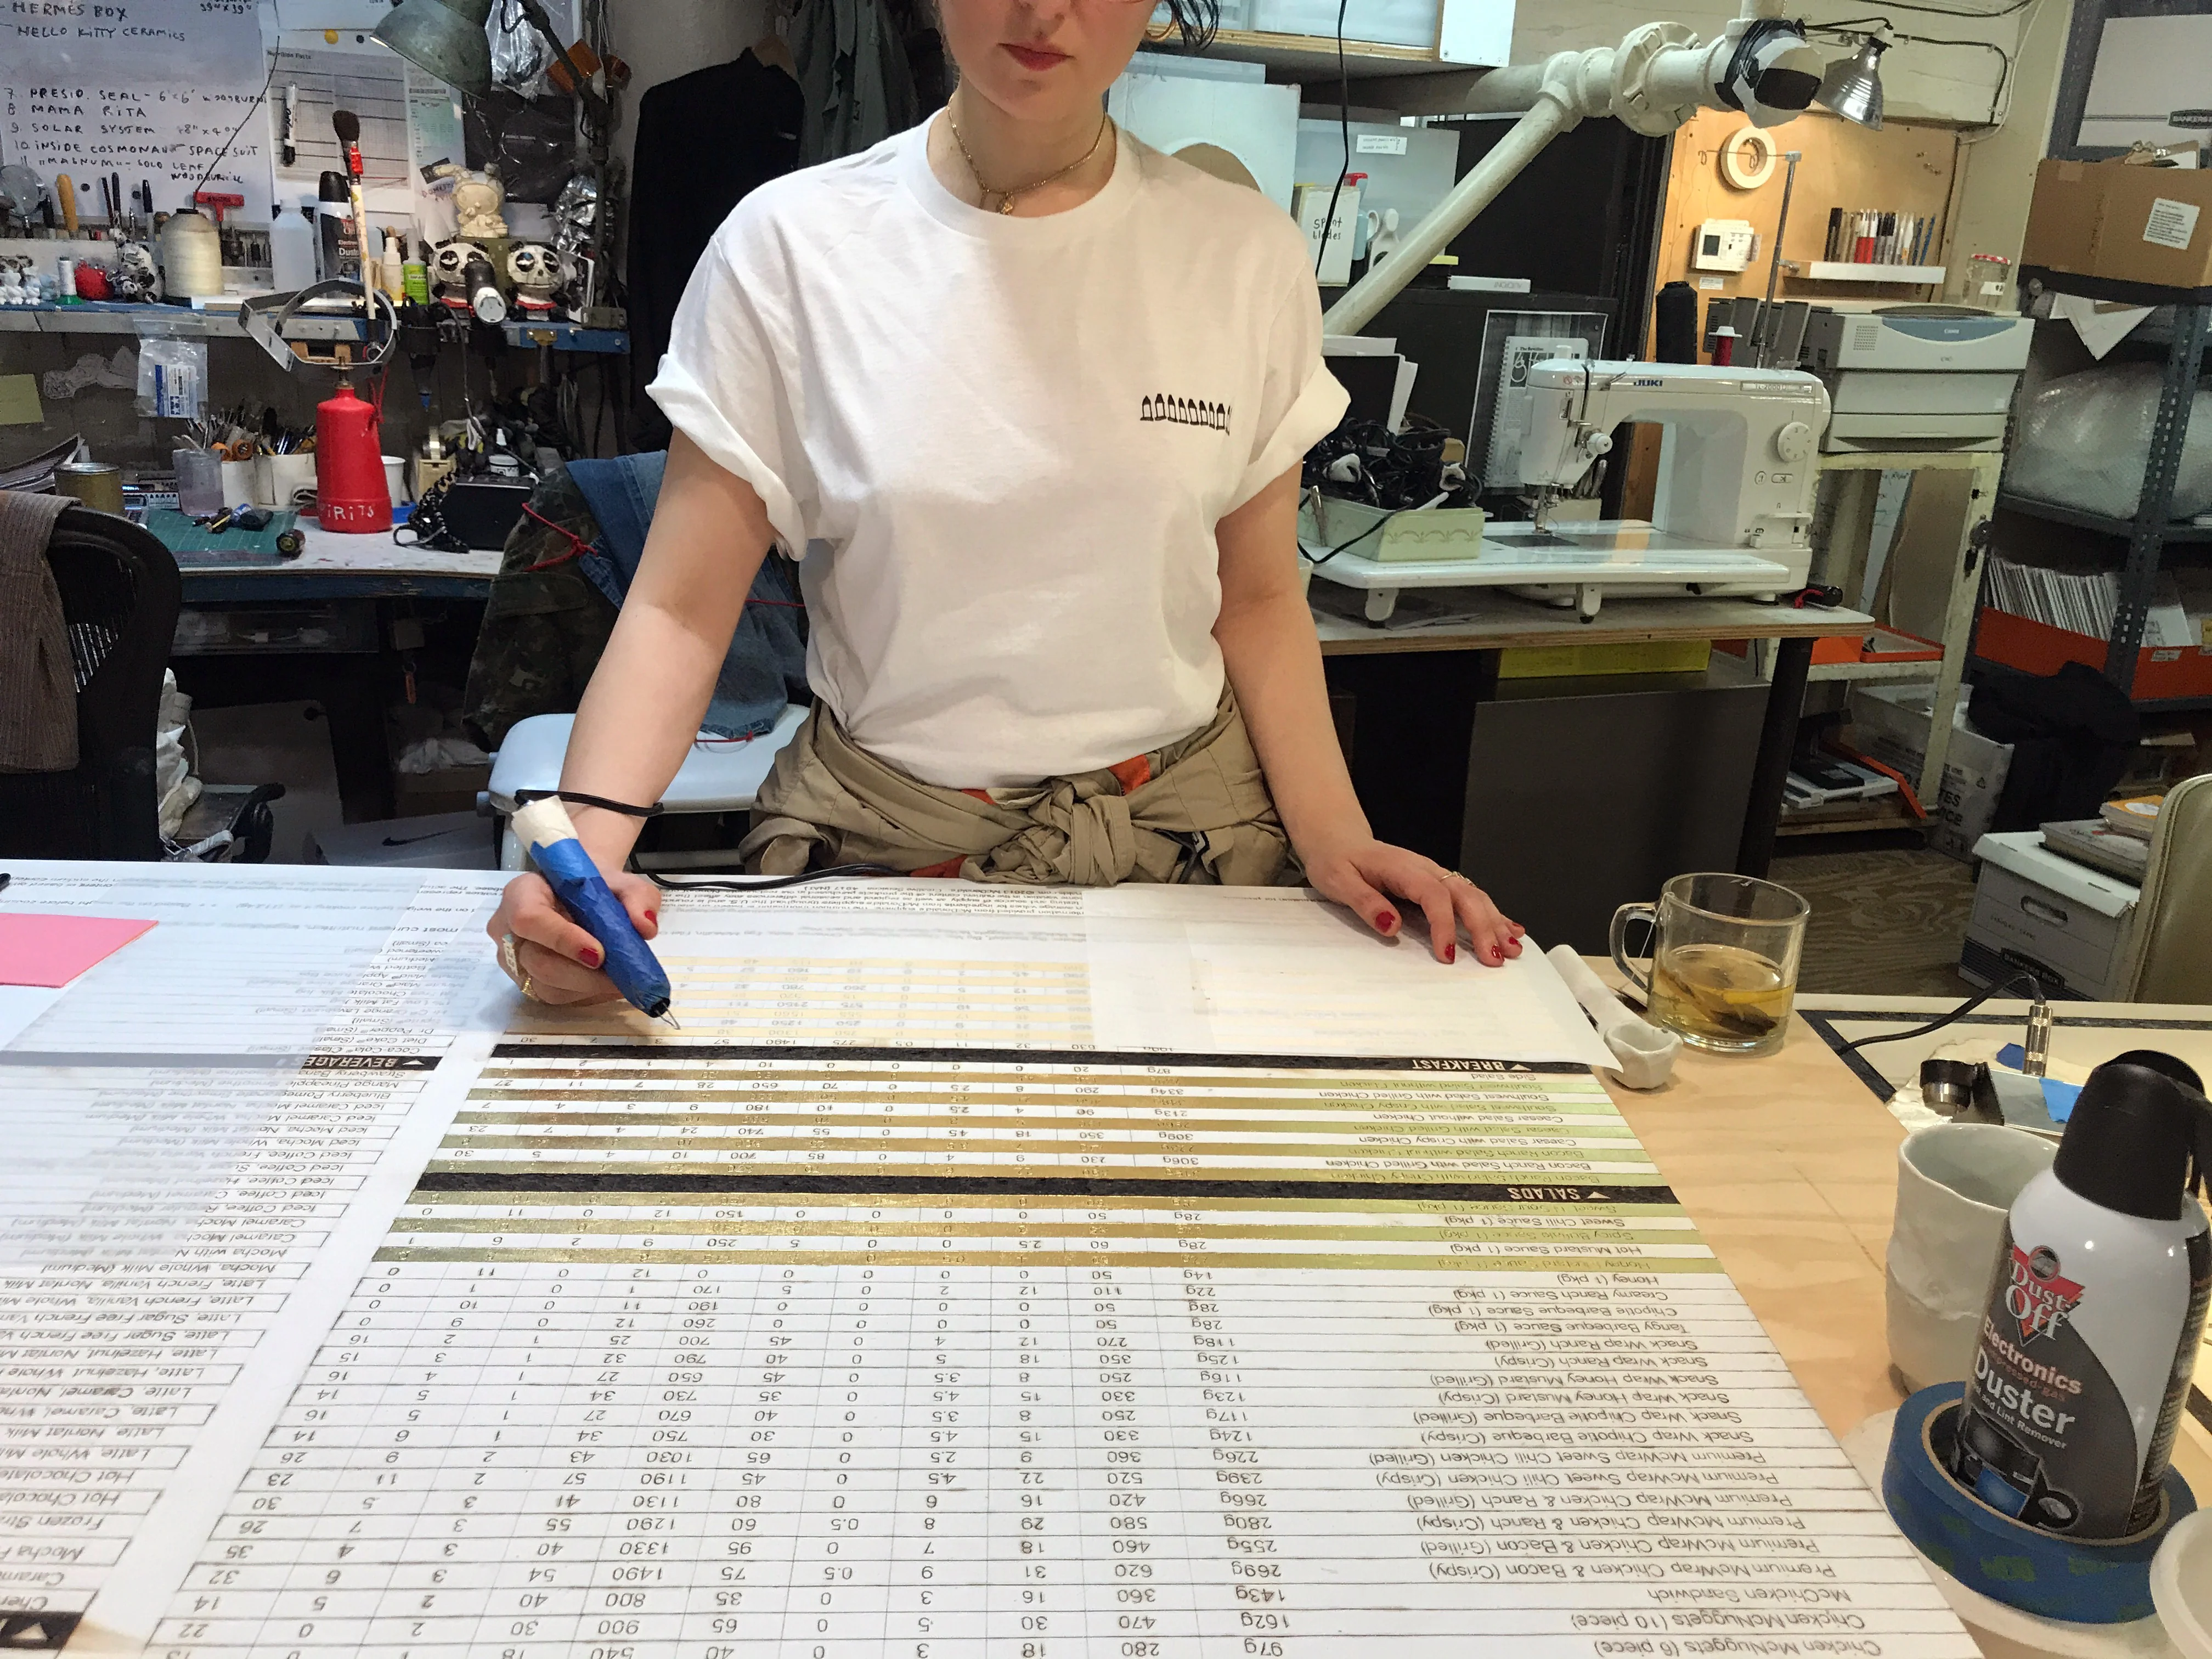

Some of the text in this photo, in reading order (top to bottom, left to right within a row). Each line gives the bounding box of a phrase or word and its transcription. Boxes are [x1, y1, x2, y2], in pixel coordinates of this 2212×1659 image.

[94, 5, 129, 21] BOX
[18, 27, 68, 39] HELLO
[99, 90, 140, 101] SEAL
[31, 105, 84, 115] MAMA
[32, 123, 83, 134] SOLAR
[100, 125, 155, 134] SYSTEM
[1313, 229, 1341, 240] bldes
[1412, 1059, 1505, 1071] BREAKFAST
[335, 1070, 405, 1078] Strawberry
[1373, 1091, 1417, 1099] Grilled
[1482, 1093, 1549, 1101] Southwest
[296, 1102, 349, 1110] Caramel
[1158, 1132, 1455, 1146] Crispy 309g
[1162, 1156, 1199, 1165] 306g
[291, 1191, 326, 1199] Iced
[1507, 1187, 1581, 1199] SALADS
[715, 1209, 1625, 1227] Sweet Chili Sauce 28g 150
[233, 1249, 287, 1257] Mocha
[1554, 1246, 1611, 1254] Mustard
[159, 1263, 210, 1273] Whole
[39, 1279, 93, 1290] Nonfat
[157, 1279, 212, 1289] French
[1557, 1274, 1589, 1285] pkg)
[1613, 1275, 1659, 1285] Honey
[1561, 1290, 1668, 1300] Creamy Ranch
[1538, 1306, 1678, 1317] Chipotle Barbeque
[2006, 1284, 2069, 1341] Off
[95, 1313, 189, 1324] Sugar Free
[1645, 1322, 1689, 1334] Tangy
[1485, 1339, 1698, 1352] Snack Wrap Ranch (Grilled)
[1197, 1352, 1240, 1367] 125g
[1984, 1315, 2083, 1395] Electronics
[1495, 1355, 1555, 1368] (Crispy)
[328, 1371, 349, 1381] 16
[1499, 1373, 1617, 1385] Honey Mustard
[1974, 1346, 2076, 1435] Duster
[2017, 1419, 2067, 1449] Remover
[1517, 1451, 1766, 1464] Premium McWrap Sweet Chili
[97, 1470, 135, 1483] Hot
[1216, 1470, 1263, 1486] 239g
[267, 1472, 1272, 1531] 280g 0.5 23
[1407, 1494, 1475, 1510] (Grilled)
[1481, 1495, 1537, 1508] Ranch
[1560, 1495, 1632, 1508] Chicken
[38, 1516, 104, 1530] Frozen
[16, 1546, 86, 1560] Mocha
[224, 1545, 1852, 1603] McChicken Sandwich 35
[1231, 1560, 1567, 1580] Bacon (Crispy) 269g
[1571, 1610, 1785, 1630] McNuggets piece)
[179, 1622, 208, 1638] 22
